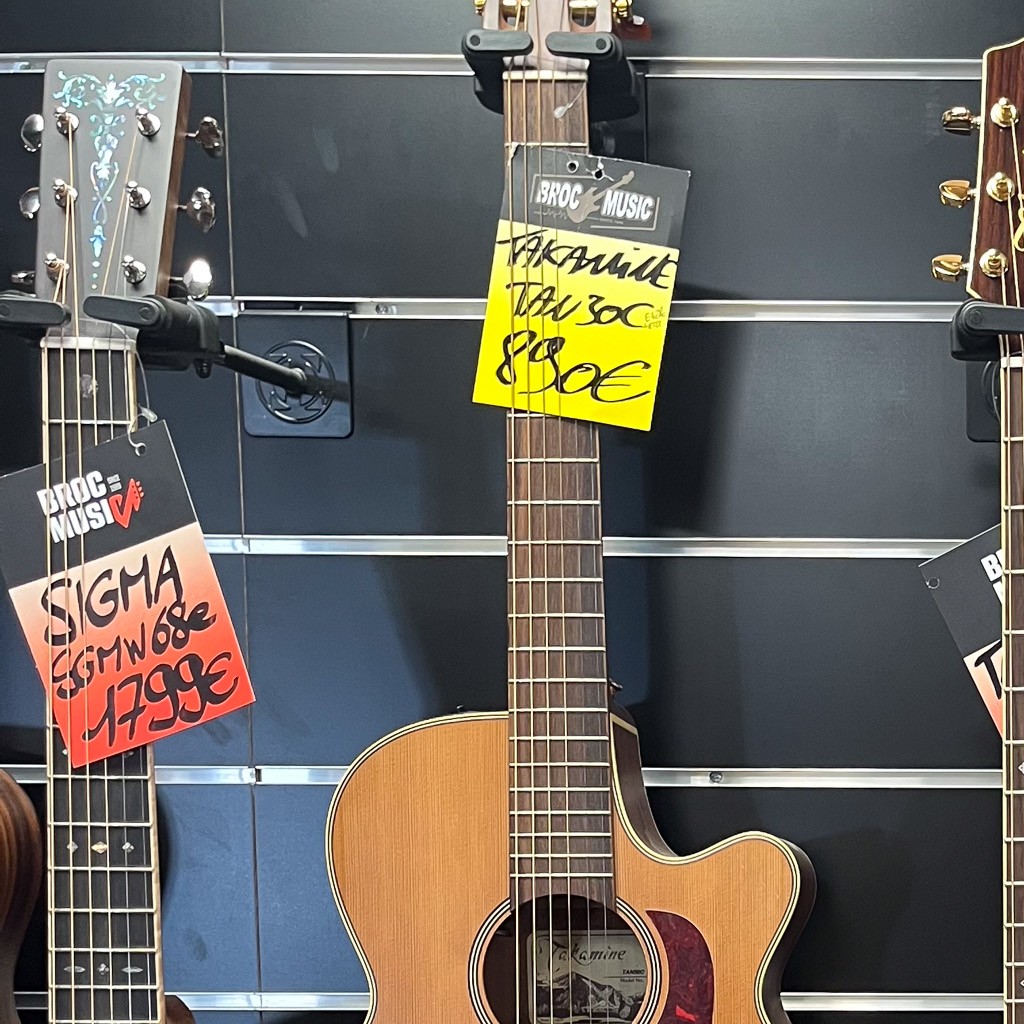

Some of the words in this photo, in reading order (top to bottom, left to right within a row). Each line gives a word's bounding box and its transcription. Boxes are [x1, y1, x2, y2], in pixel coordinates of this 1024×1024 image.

[535, 180, 583, 210] BROC
[601, 188, 655, 221] MUSIC
[36, 470, 107, 517] BROC
[40, 545, 184, 647] SIGMA
[82, 652, 240, 748] 1799€
[538, 938, 627, 972] Takamine
